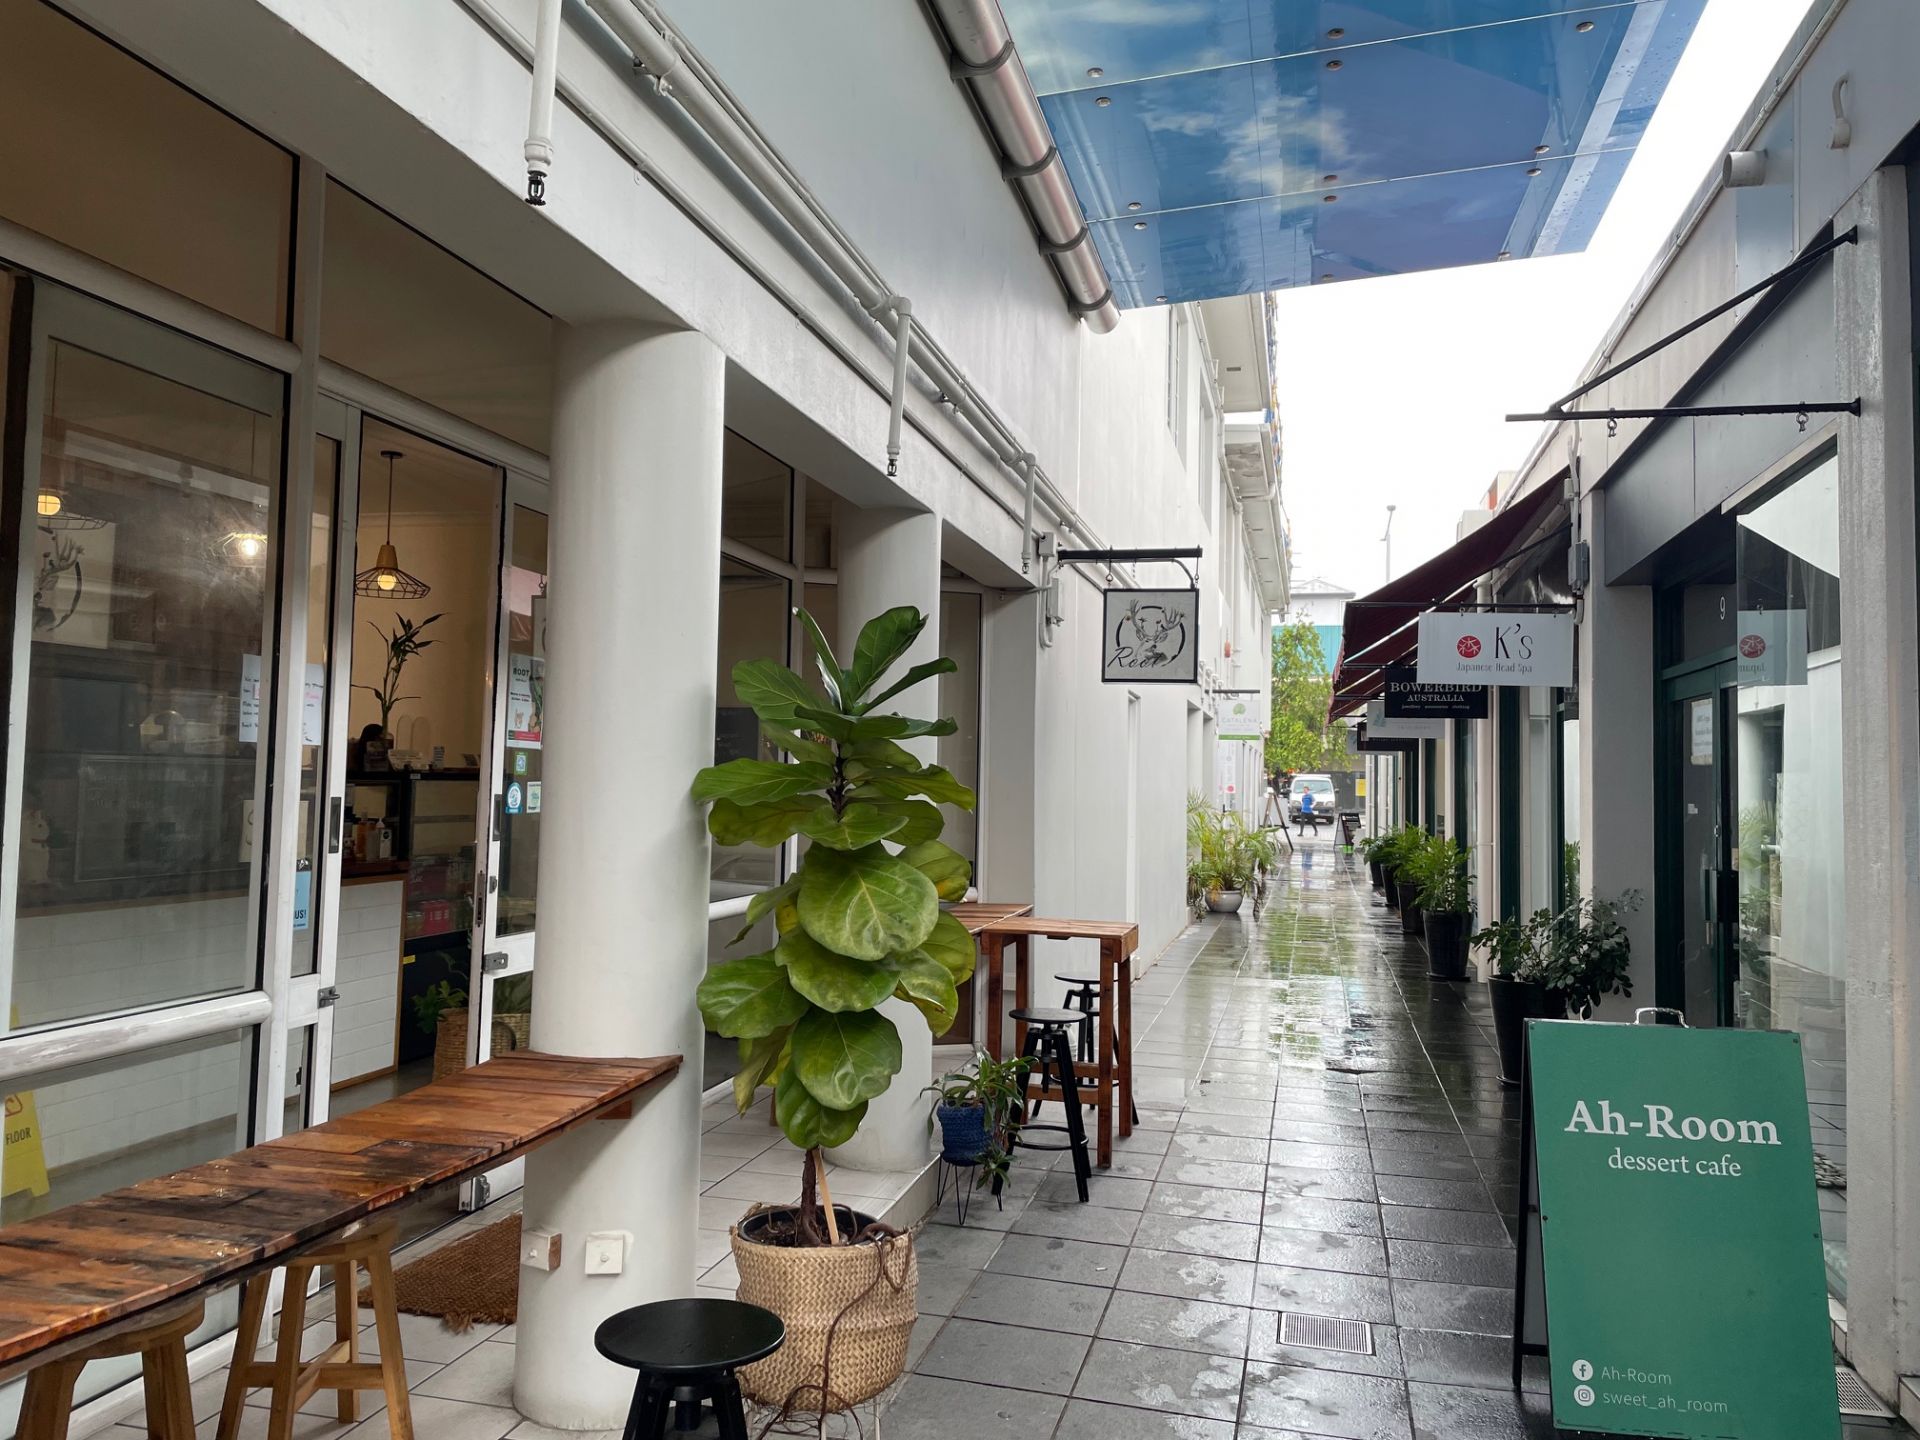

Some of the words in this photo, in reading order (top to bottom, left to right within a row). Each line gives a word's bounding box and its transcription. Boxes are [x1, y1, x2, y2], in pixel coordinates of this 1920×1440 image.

[1719, 596, 1726, 620] 9
[1495, 623, 1533, 660] K's
[1456, 661, 1492, 673] Japanese
[1495, 662, 1515, 672] Head
[1518, 663, 1532, 675] Spa
[1390, 682, 1482, 693] BOWERBIRD
[1407, 694, 1464, 702] AUSTRALIA
[1564, 1100, 1782, 1145] Ah-Room
[6, 1127, 31, 1145] FLOOR
[1608, 1147, 1690, 1174] dessert
[1695, 1154, 1742, 1177] cafe
[1601, 1366, 1672, 1385] Ah-Room
[1603, 1392, 1728, 1413] sweet_ah_room
